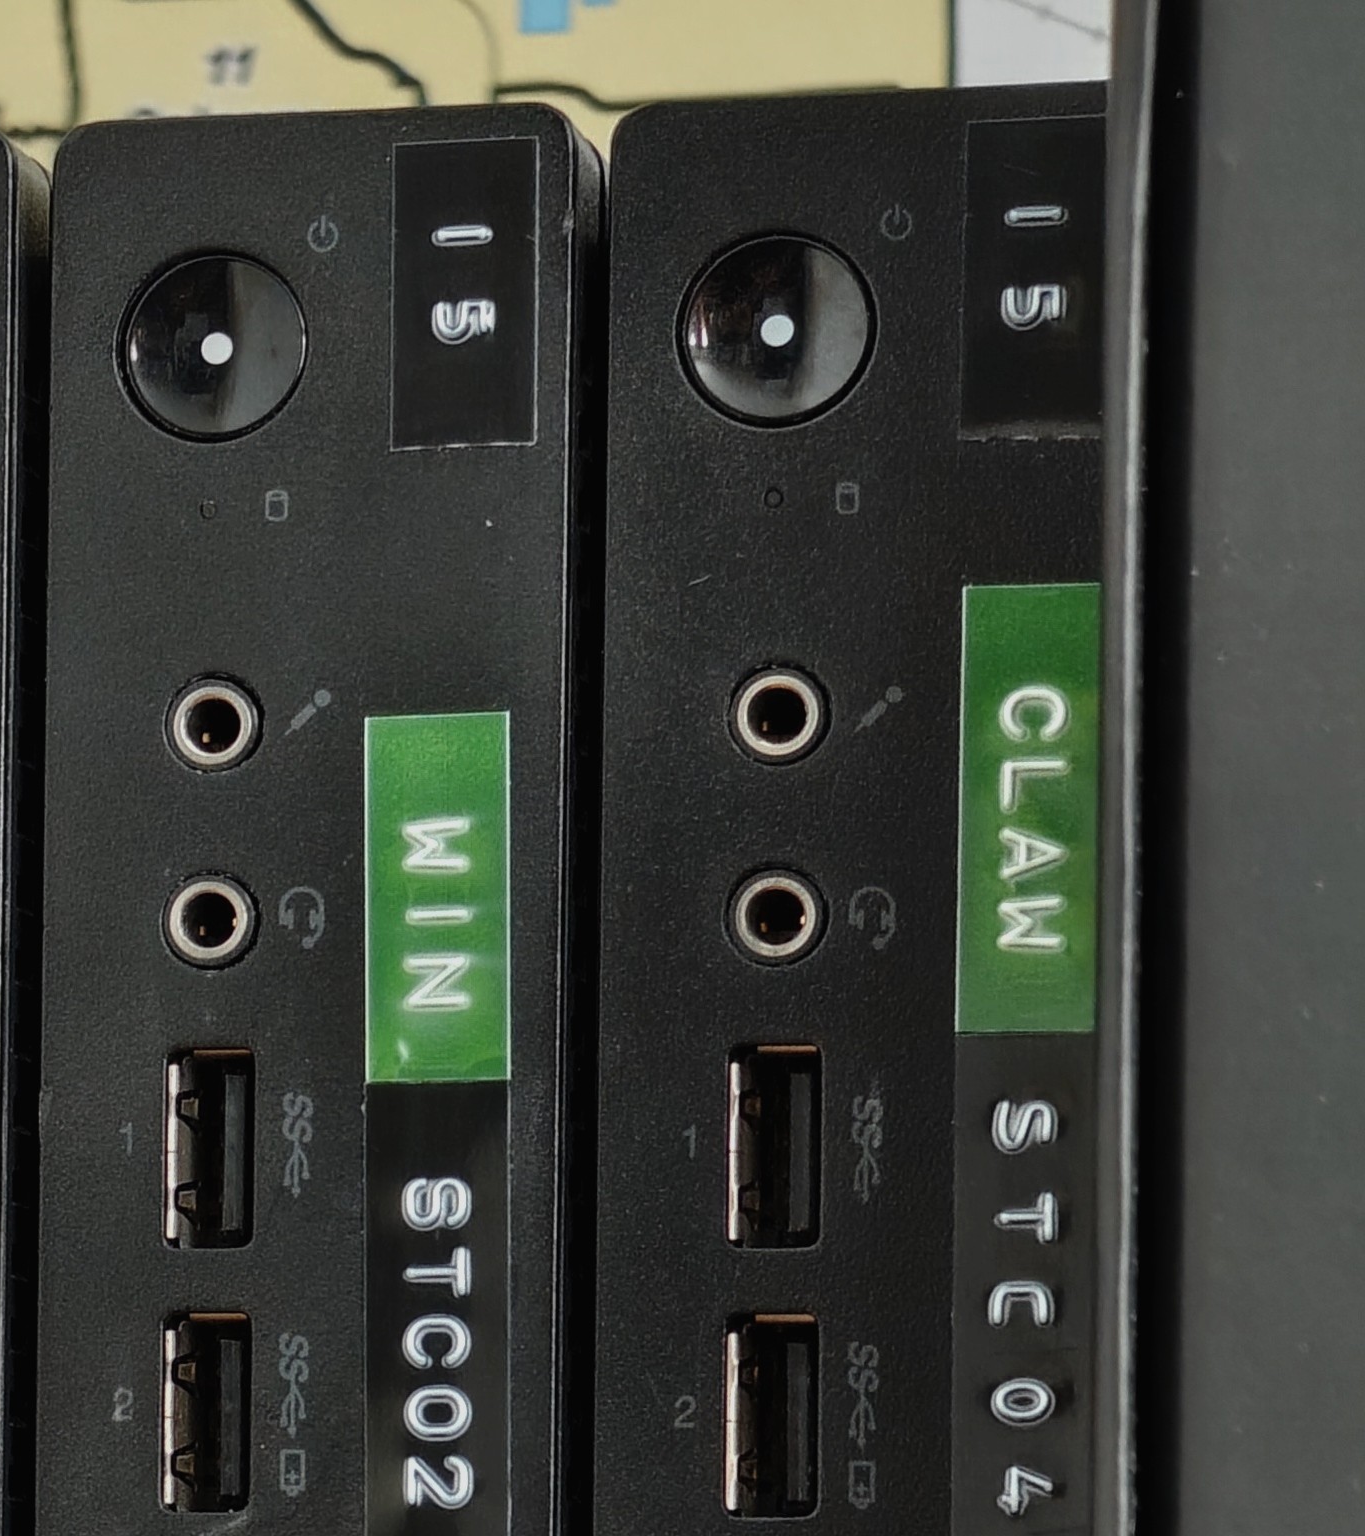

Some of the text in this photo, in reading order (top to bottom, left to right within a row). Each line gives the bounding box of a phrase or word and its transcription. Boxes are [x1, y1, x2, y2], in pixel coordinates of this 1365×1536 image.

[996, 685, 1070, 954] CLAW
[402, 816, 473, 1012] WIN
[119, 1124, 134, 1153] 1
[682, 1127, 698, 1159] 1
[401, 1176, 473, 1509] STC02
[987, 1098, 1060, 1517] STC04
[111, 1389, 134, 1421] 2
[674, 1398, 696, 1430] 2
